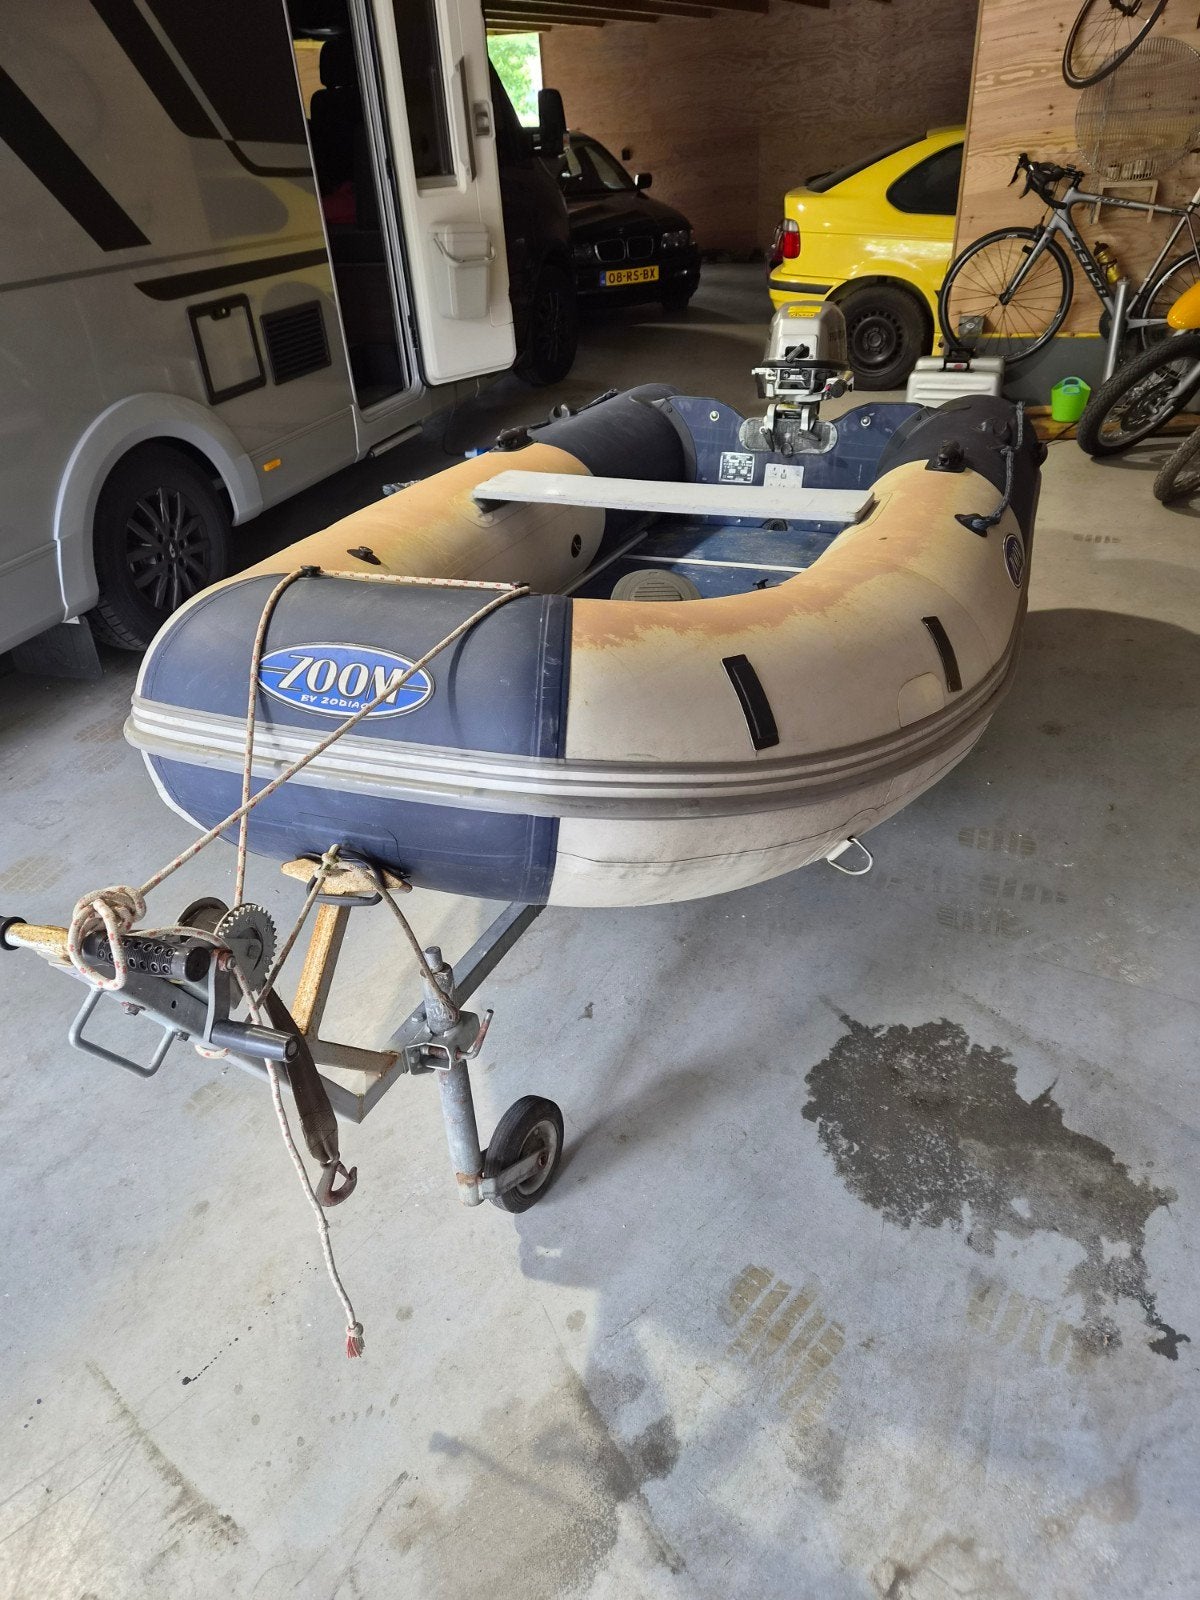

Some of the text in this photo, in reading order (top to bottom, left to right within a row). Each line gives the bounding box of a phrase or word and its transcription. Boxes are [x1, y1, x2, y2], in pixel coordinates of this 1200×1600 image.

[608, 267, 656, 284] 08-RS-BX
[278, 655, 404, 705] ZOOM
[301, 694, 317, 703] BY
